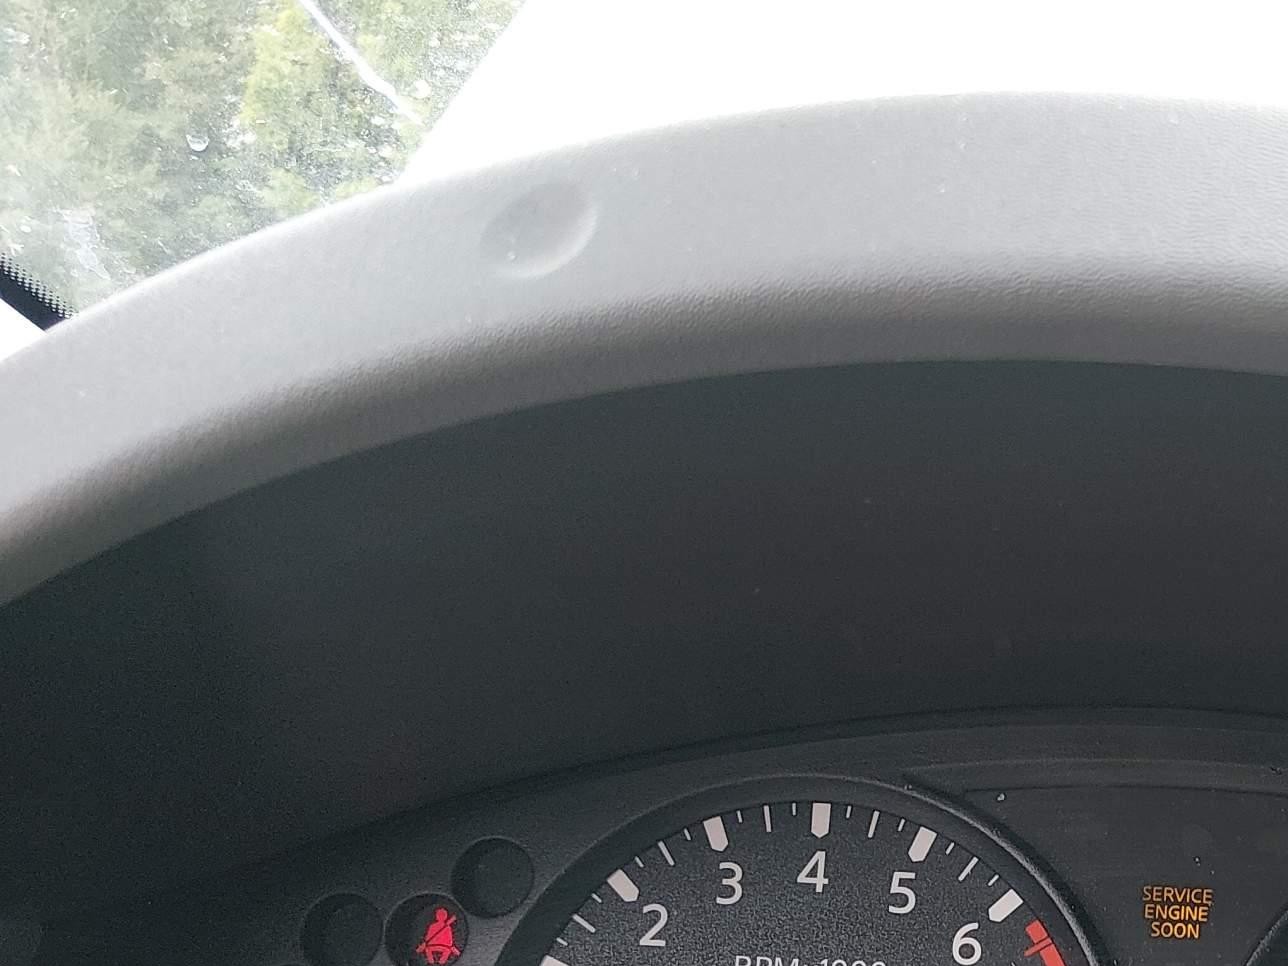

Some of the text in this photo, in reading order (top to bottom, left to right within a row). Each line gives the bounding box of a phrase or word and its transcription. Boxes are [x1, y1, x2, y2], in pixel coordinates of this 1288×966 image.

[715, 862, 744, 904] 3
[797, 850, 829, 892] 4
[888, 871, 917, 914] 5
[1142, 886, 1213, 905] SERVICE
[1144, 903, 1209, 923] ENGINE
[639, 903, 667, 946] 2
[952, 922, 982, 966] 6
[1150, 921, 1200, 938] SOON
